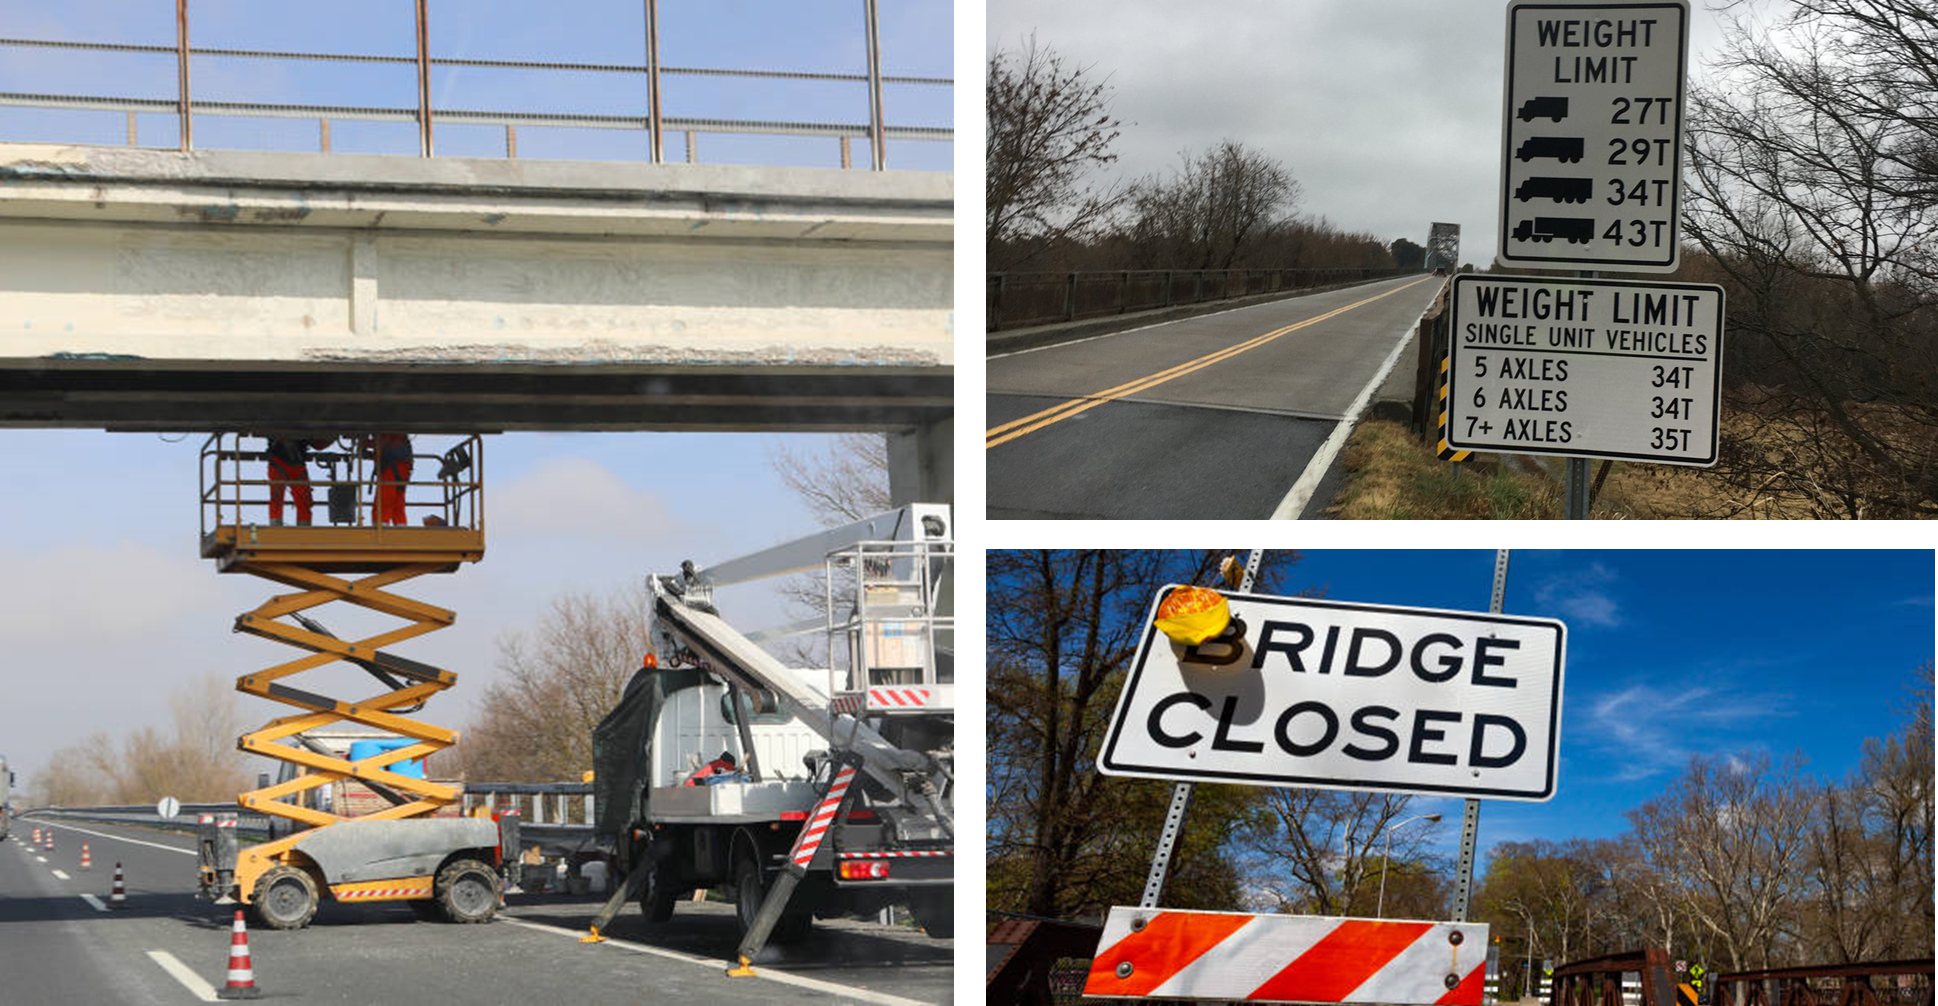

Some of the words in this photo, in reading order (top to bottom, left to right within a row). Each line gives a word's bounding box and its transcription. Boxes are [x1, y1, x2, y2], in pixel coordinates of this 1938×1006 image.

[1537, 20, 1657, 47] WEIGHT
[1554, 56, 1638, 83] LIMIT
[1611, 97, 1672, 124] 27T
[1608, 138, 1670, 165] 29T
[1606, 179, 1669, 206] 34T
[1603, 219, 1667, 247] 43T
[1476, 286, 1594, 321] WEIGHT
[1612, 292, 1700, 327] LIMIT
[1465, 323, 1537, 345] SINGLE
[1549, 326, 1595, 348] UNIT
[1606, 329, 1708, 355] VEHICLES
[1474, 356, 1487, 378] 5
[1499, 357, 1569, 382] AXLES
[1651, 365, 1694, 389] 34T
[1473, 387, 1486, 408] 6
[1498, 388, 1568, 412] AXLES
[1650, 396, 1693, 420] 34T
[1465, 416, 1493, 438] 7+
[1503, 418, 1572, 443] AXLES
[1650, 427, 1692, 451] 35T
[1182, 617, 1521, 688] BRIDGE
[1146, 692, 1527, 768] CLOSED
